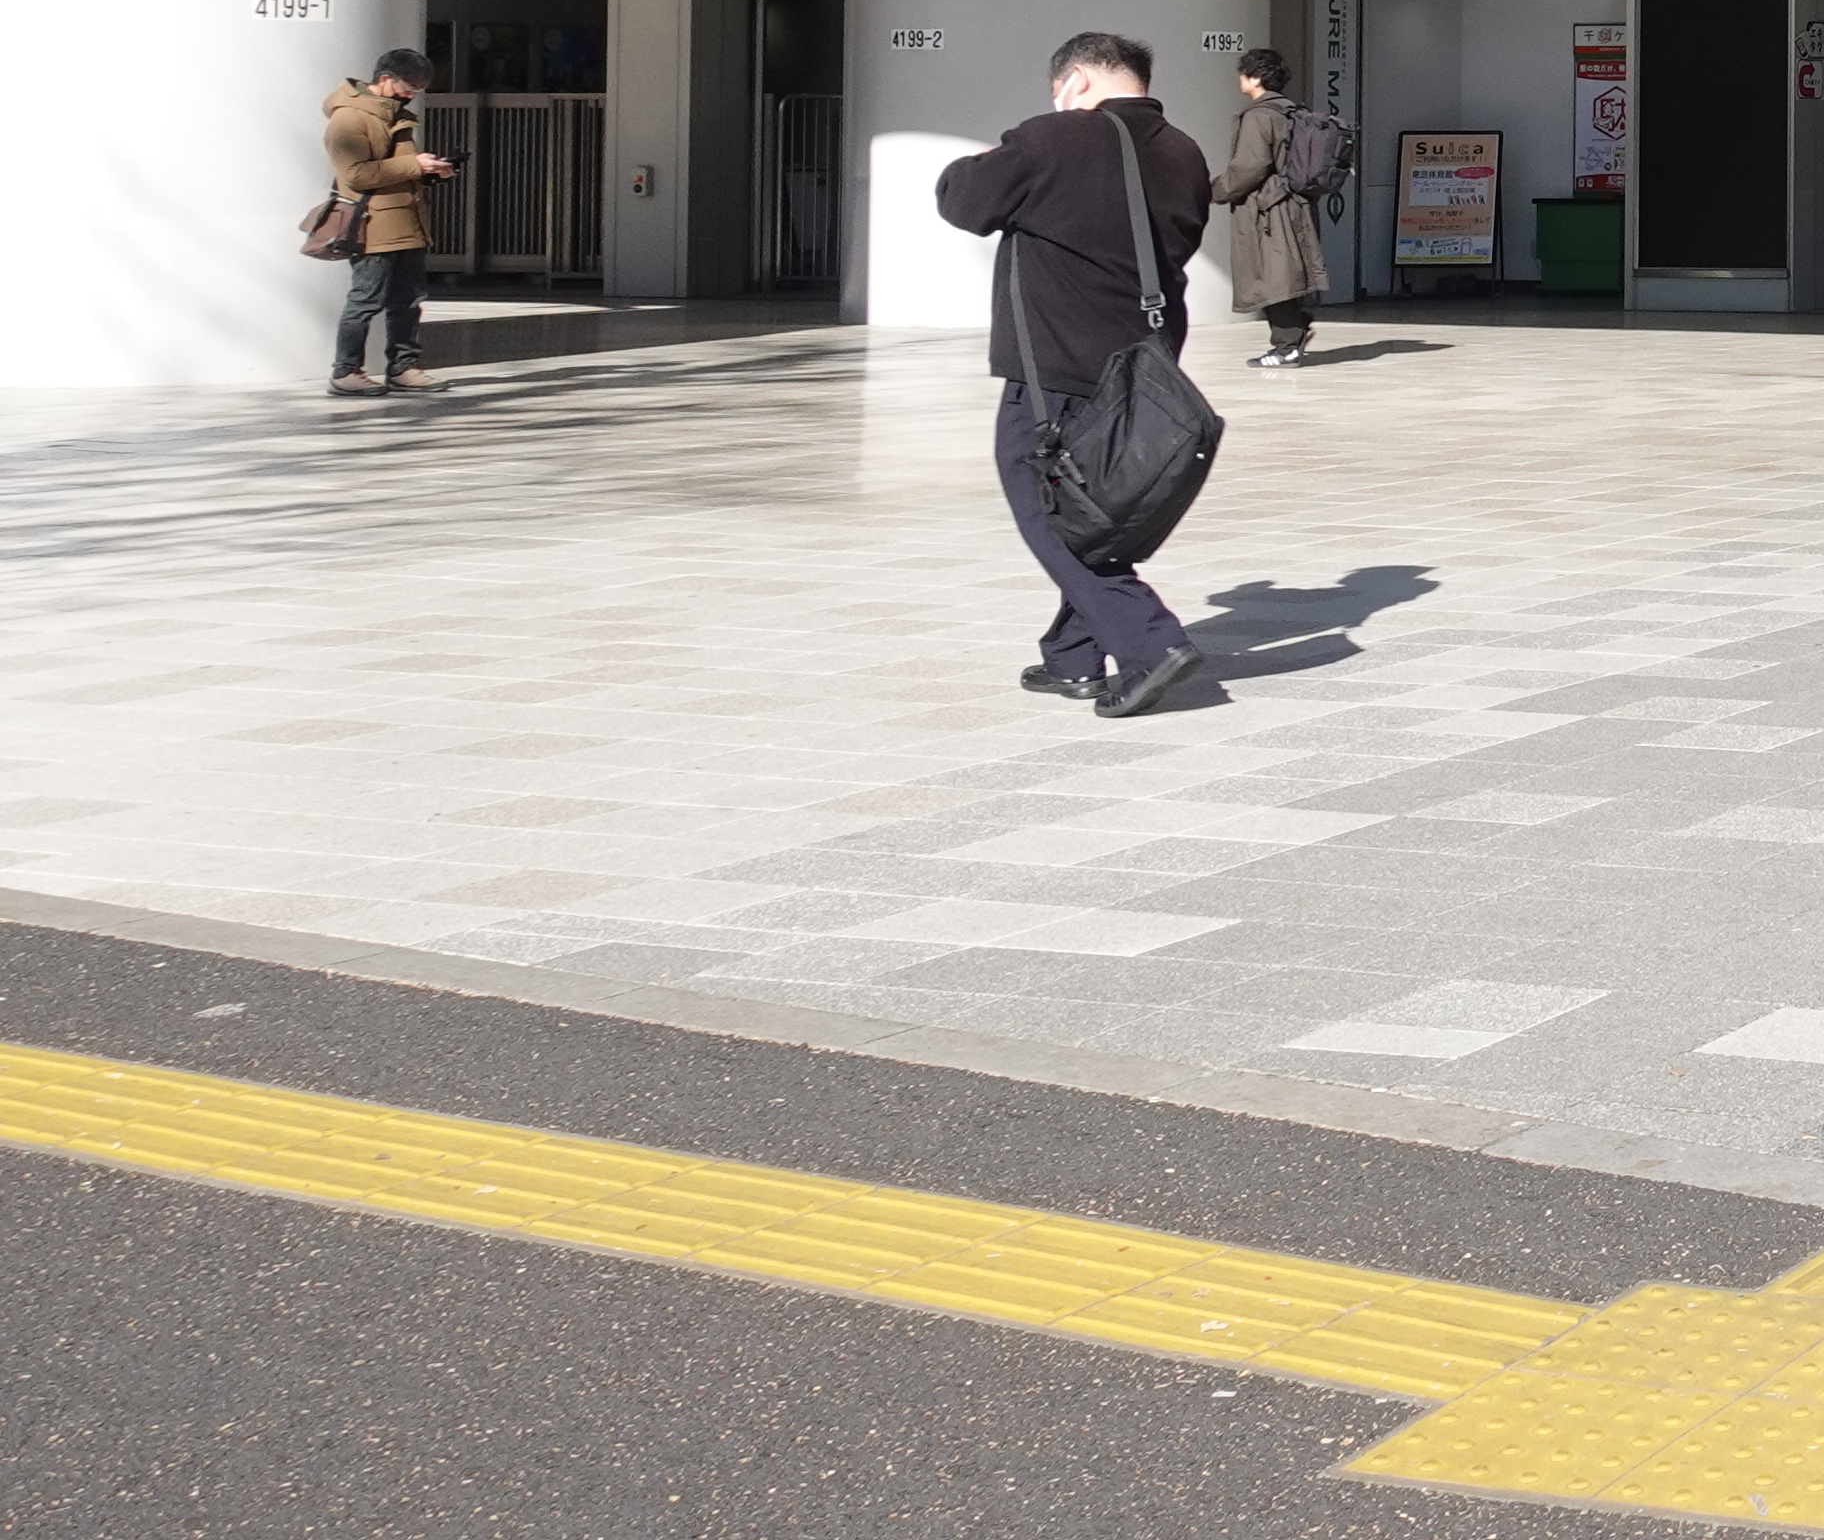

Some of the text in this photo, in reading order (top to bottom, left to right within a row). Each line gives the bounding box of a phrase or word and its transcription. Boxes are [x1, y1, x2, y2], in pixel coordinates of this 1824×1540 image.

[892, 31, 943, 48] 4199-2
[1203, 34, 1244, 51] 4199-2
[1415, 141, 1484, 155] Suica
